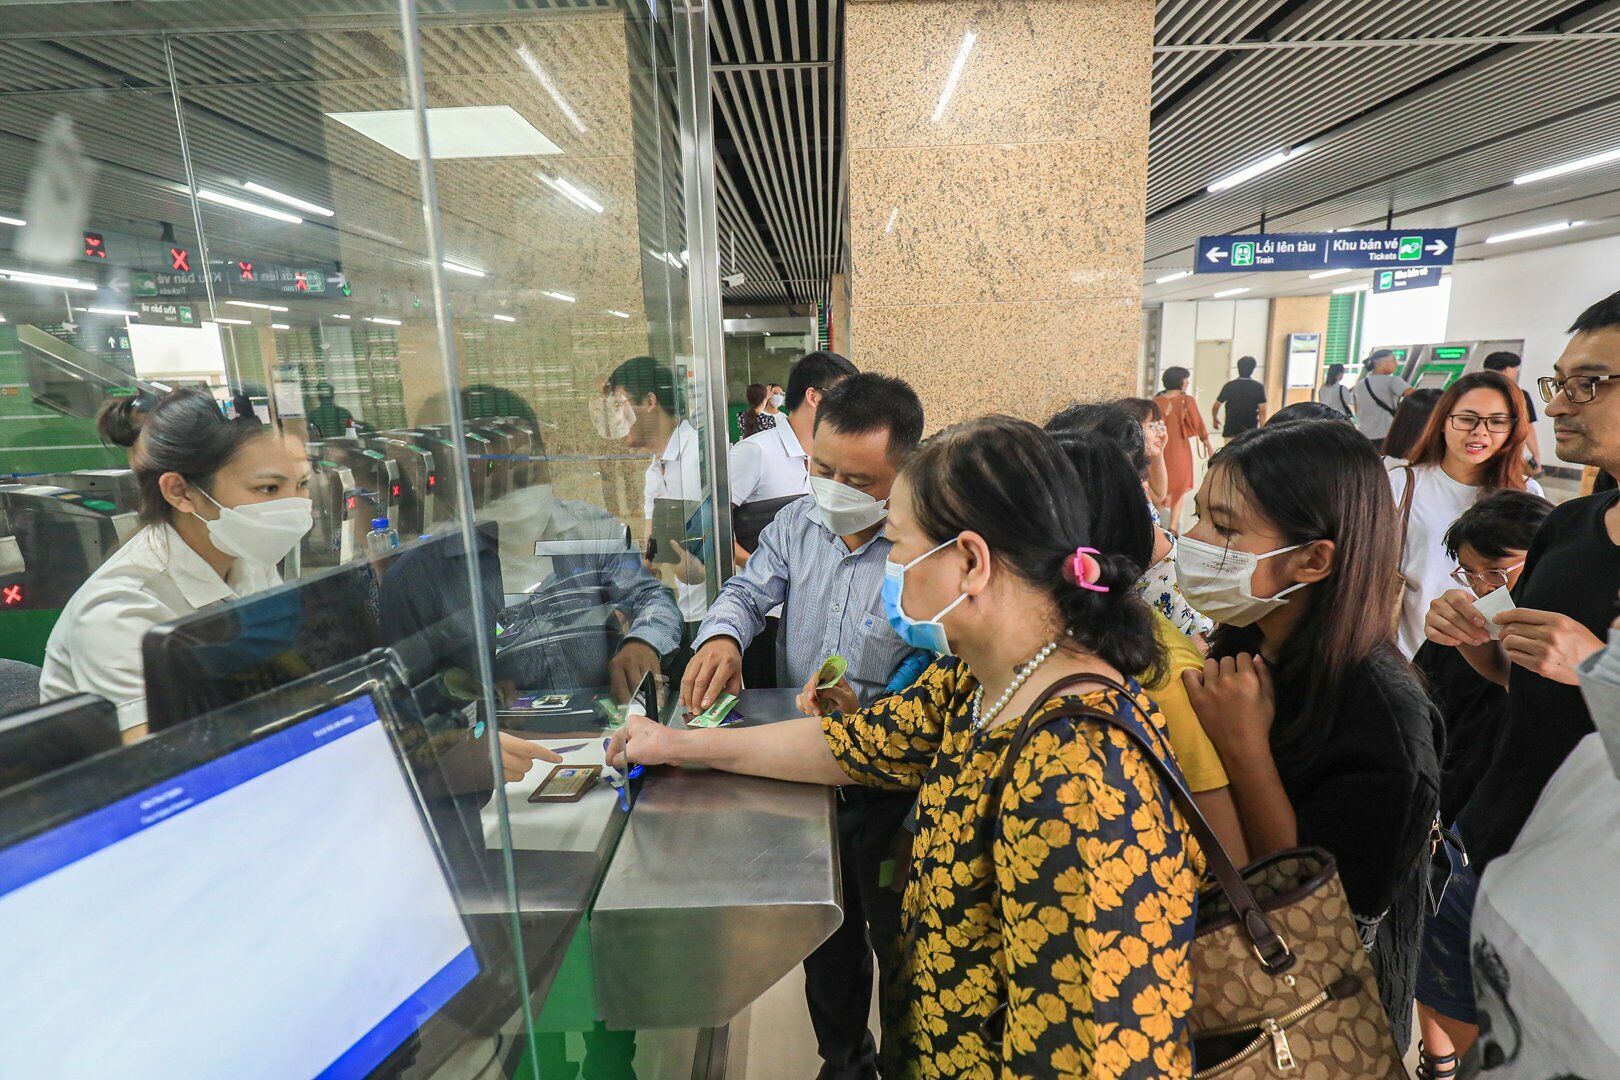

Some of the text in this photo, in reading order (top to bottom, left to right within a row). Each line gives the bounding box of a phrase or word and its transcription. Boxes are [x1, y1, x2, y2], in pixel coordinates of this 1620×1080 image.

[1255, 239, 1316, 254] Lối lên tàu
[1333, 237, 1399, 251] Khu bán vé
[1254, 255, 1275, 264] Train
[1368, 251, 1398, 261] Tickets
